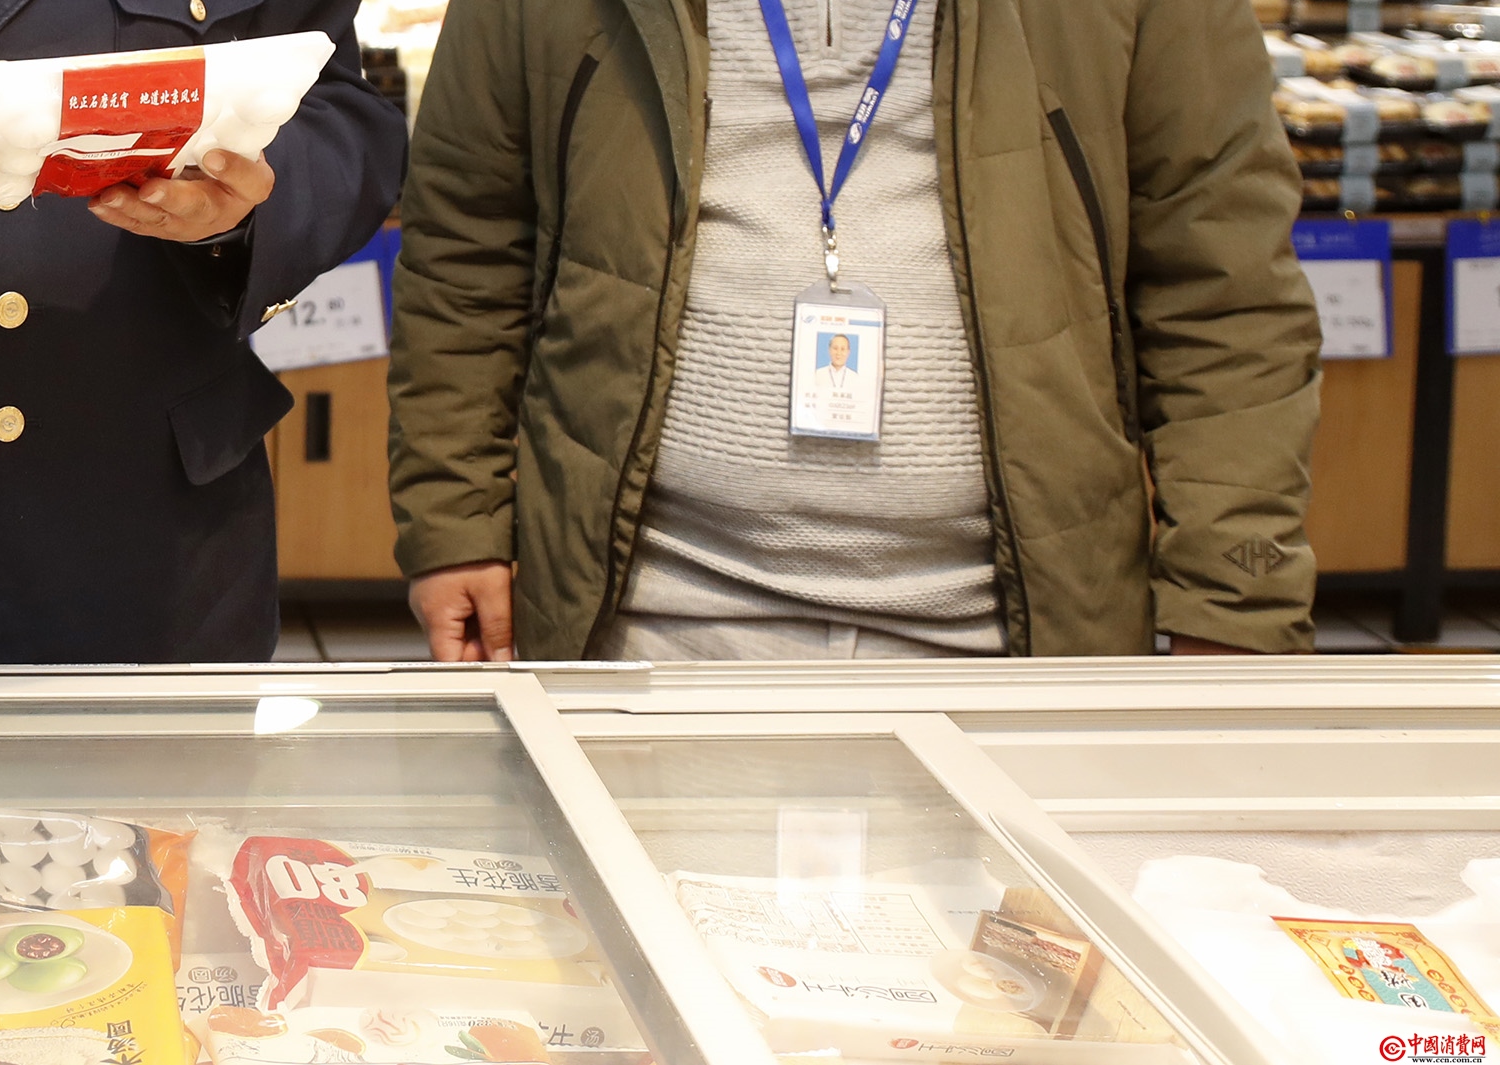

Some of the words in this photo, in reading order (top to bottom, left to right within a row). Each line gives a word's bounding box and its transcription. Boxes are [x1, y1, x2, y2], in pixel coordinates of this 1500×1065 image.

[69, 91, 130, 110] 纯正石磨元宵
[139, 87, 200, 106] 地道北京风味
[265, 855, 368, 908] 80
[446, 867, 565, 892] 香脆花生
